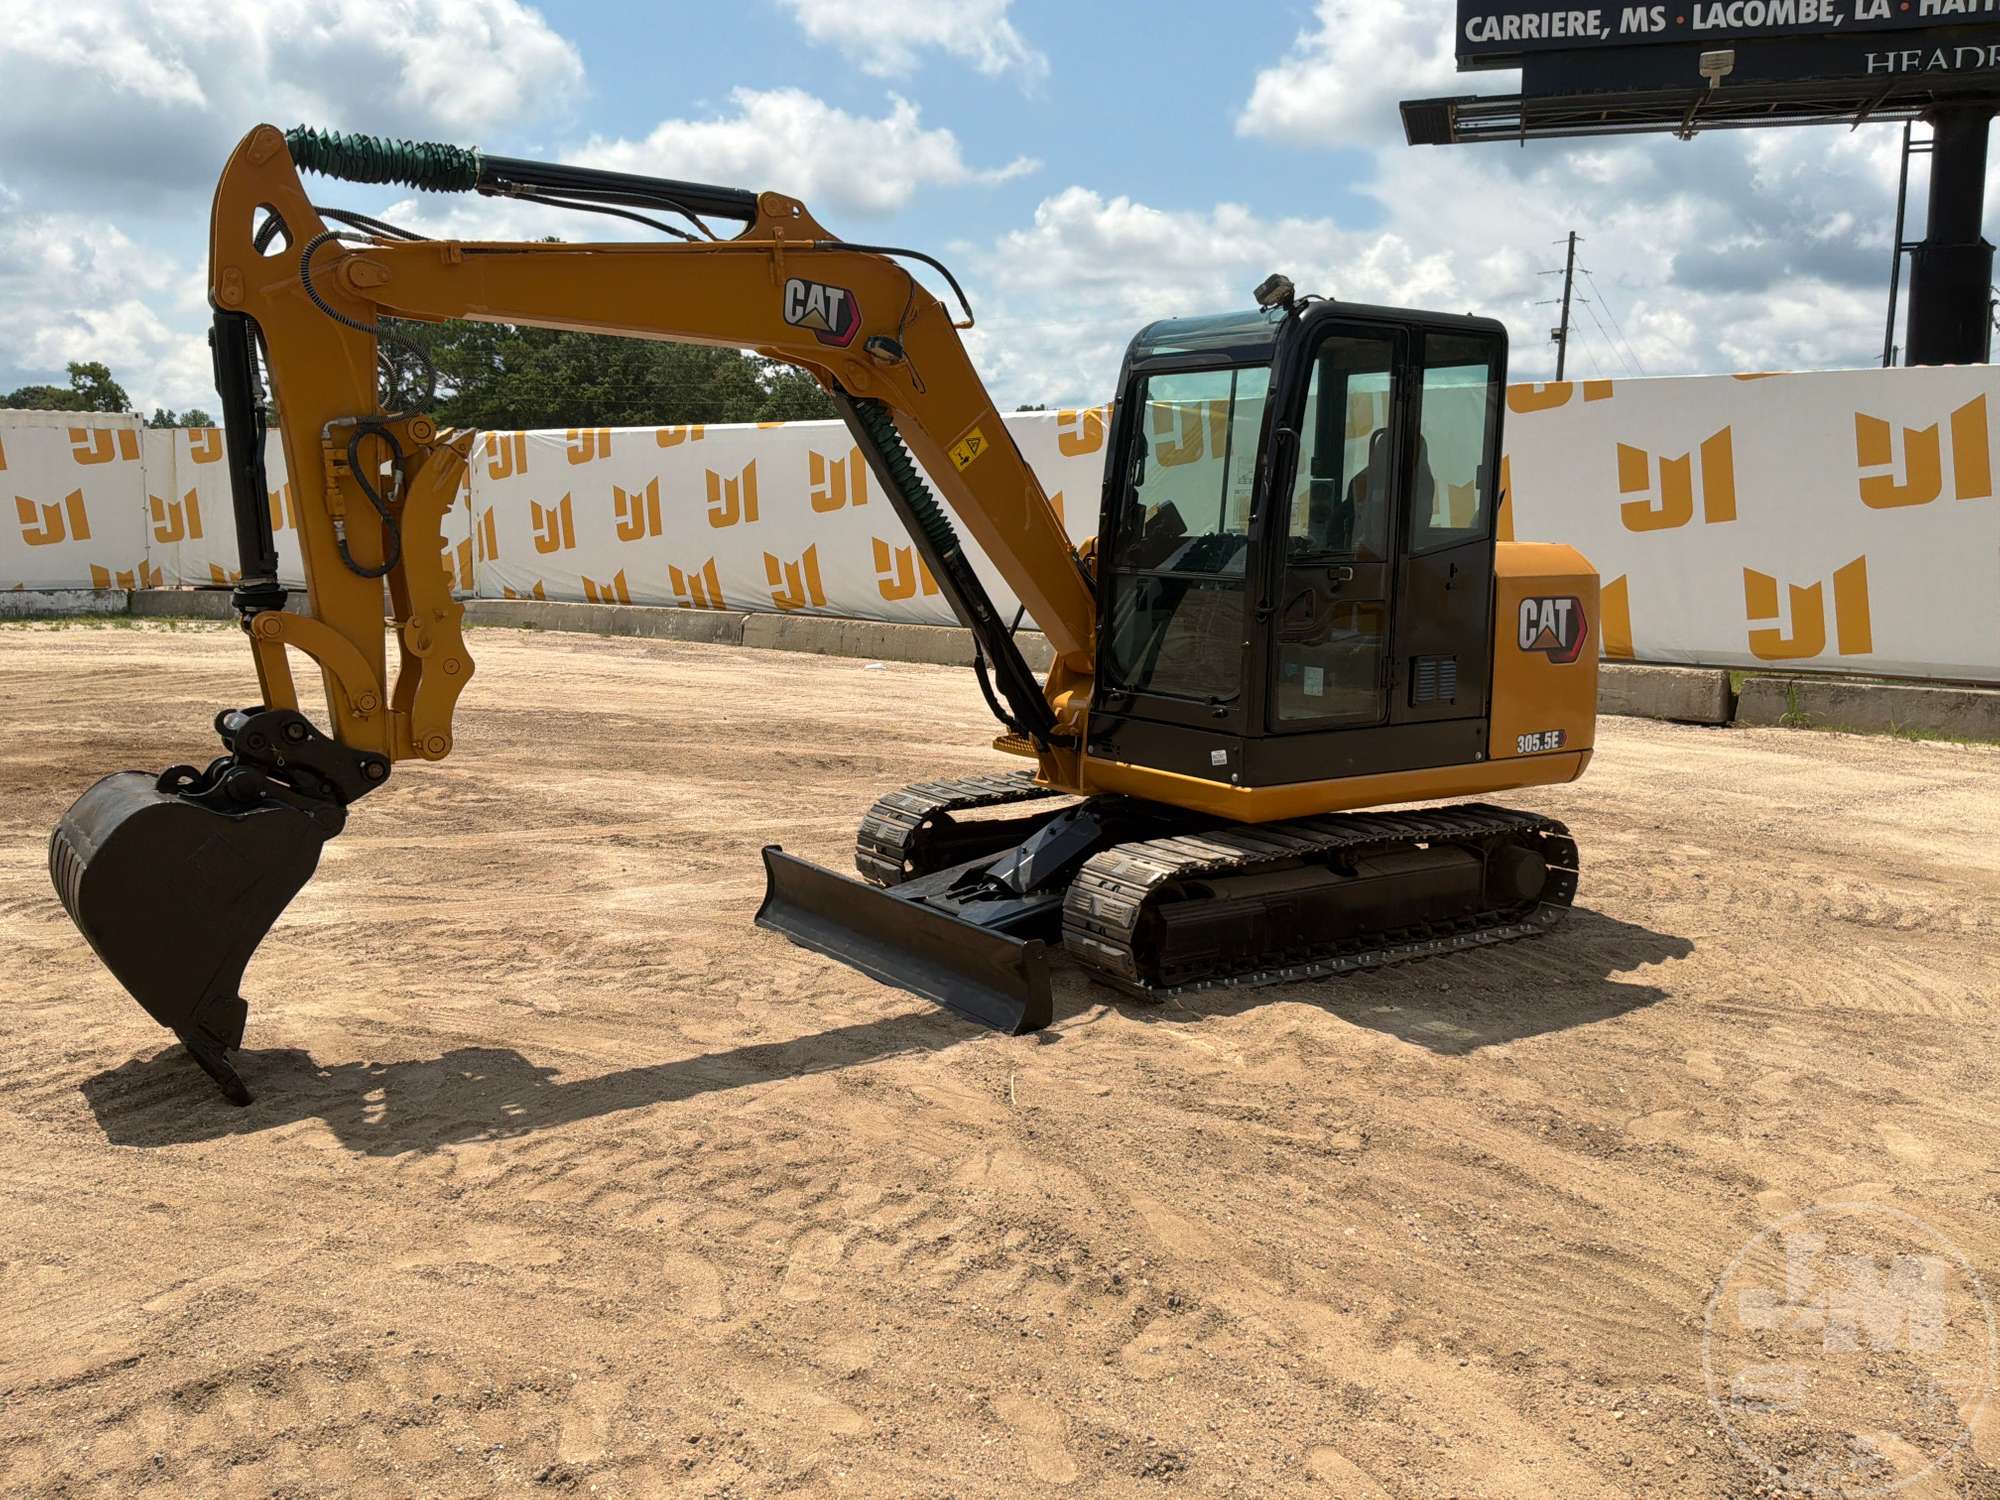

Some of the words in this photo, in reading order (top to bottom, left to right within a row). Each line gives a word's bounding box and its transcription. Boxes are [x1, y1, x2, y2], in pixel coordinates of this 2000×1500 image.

[1465, 10, 1610, 42] CARRIERE,
[1620, 6, 1666, 34] MS
[1692, 0, 1844, 30] LACOMBE,
[1855, 0, 1892, 20] LA
[784, 278, 845, 332] CAT
[1519, 599, 1571, 650] CAT
[1517, 731, 1559, 753] 305.5E
